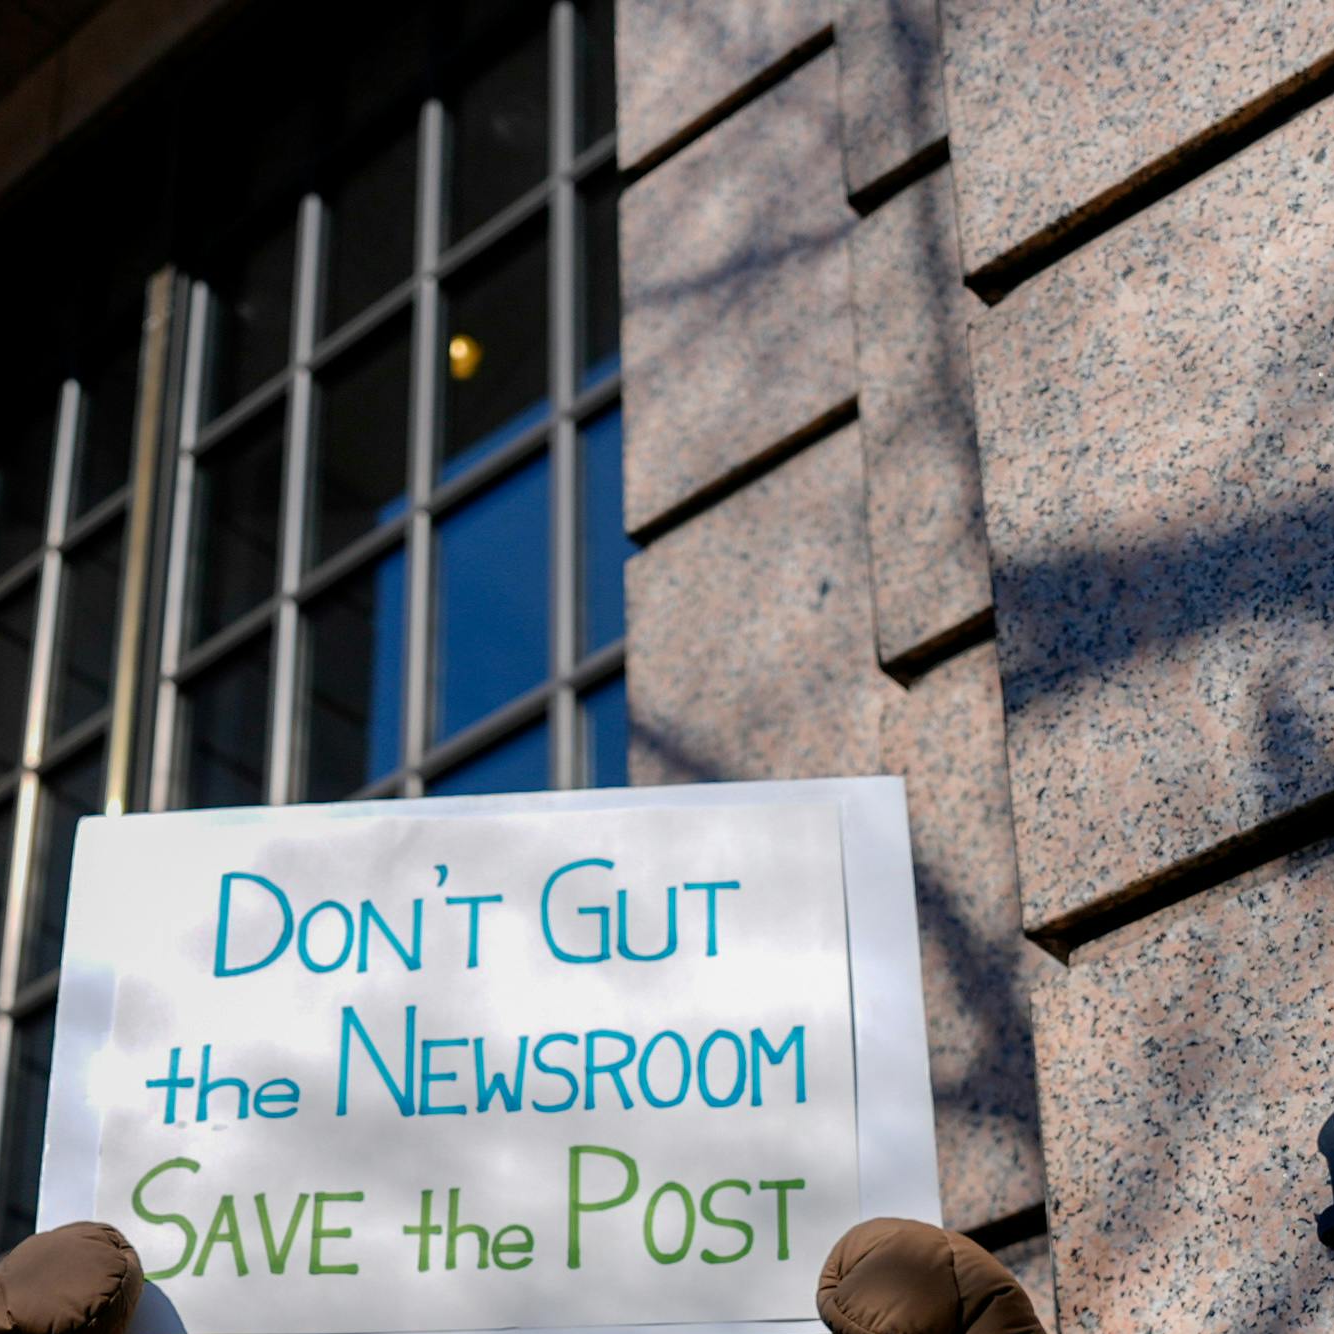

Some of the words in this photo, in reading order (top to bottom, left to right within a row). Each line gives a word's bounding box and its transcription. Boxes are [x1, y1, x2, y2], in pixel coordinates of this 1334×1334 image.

[214, 863, 503, 978] DON'T
[540, 858, 740, 964] GUT
[146, 1043, 301, 1125] the
[336, 1005, 807, 1117] NEWSROOM
[131, 1157, 364, 1281] SAVE
[403, 1187, 535, 1273] the
[568, 1145, 806, 1269] POST
